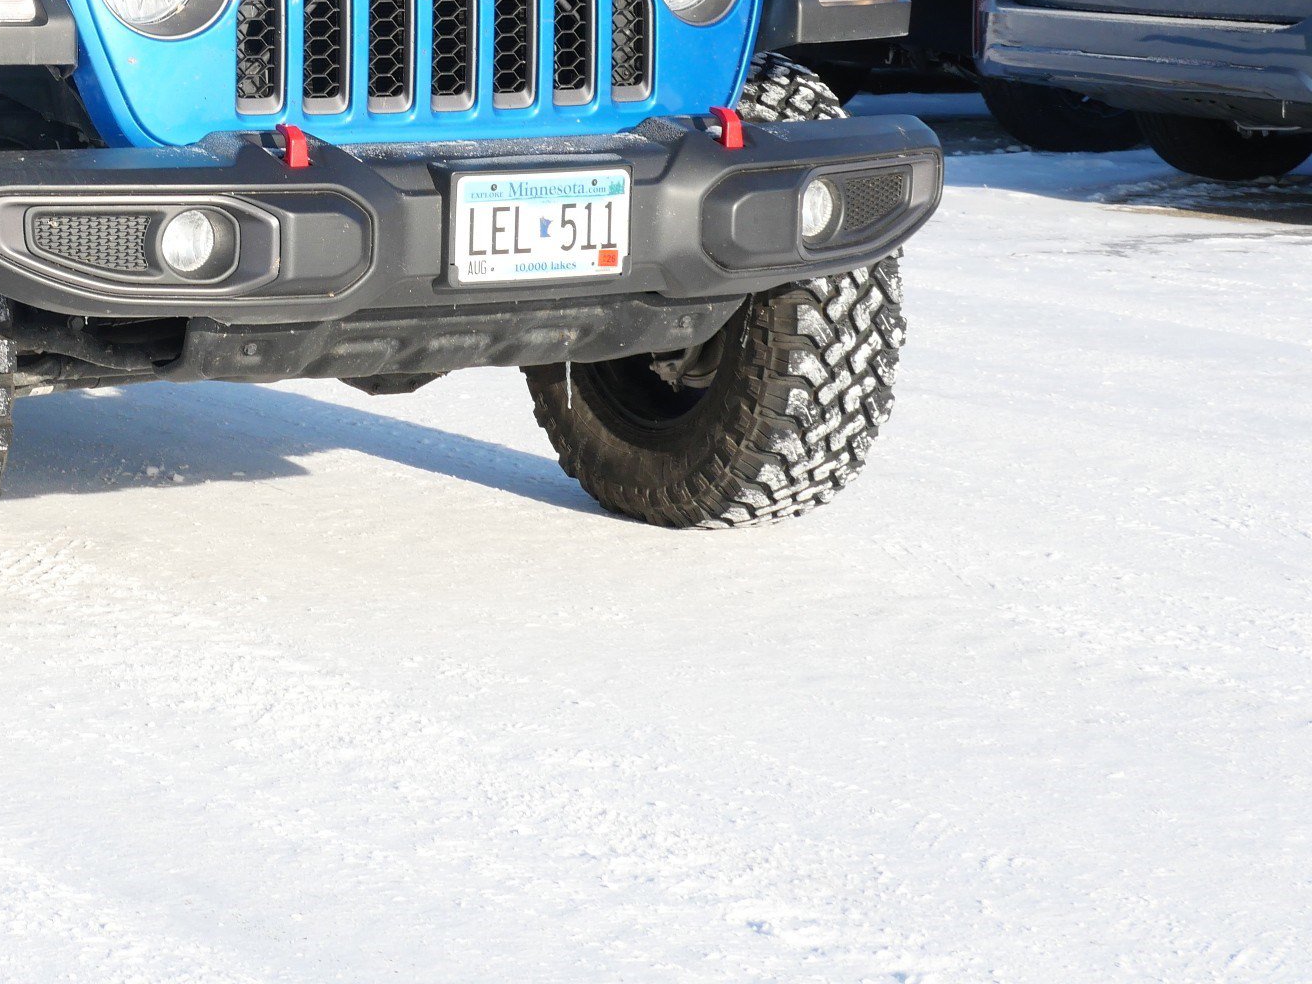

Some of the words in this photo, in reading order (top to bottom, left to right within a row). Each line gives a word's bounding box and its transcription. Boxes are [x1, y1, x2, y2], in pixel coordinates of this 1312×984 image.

[468, 206, 532, 256] LEL
[560, 201, 617, 251] 511
[467, 260, 487, 276] AUG
[515, 262, 548, 273] 10,000
[550, 261, 577, 271] lakes
